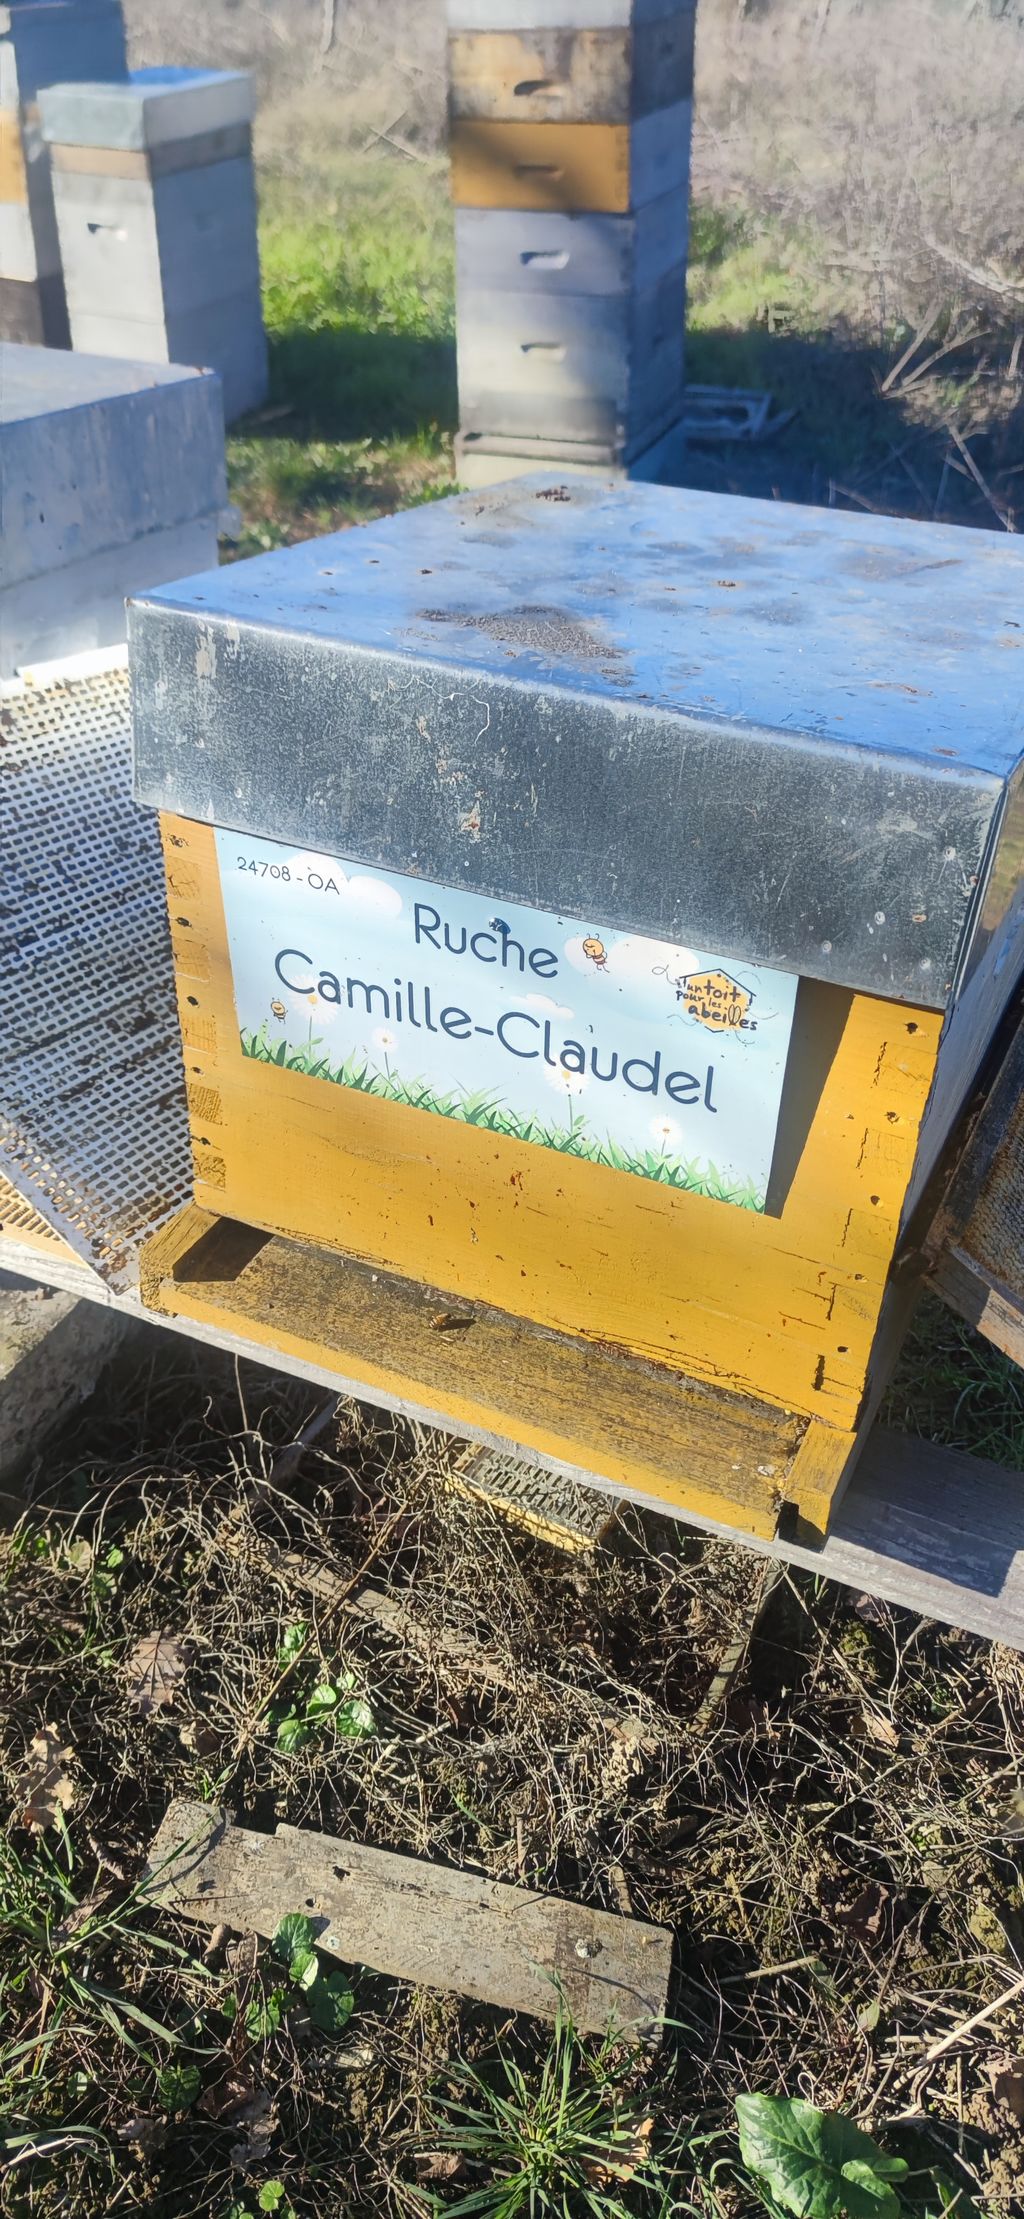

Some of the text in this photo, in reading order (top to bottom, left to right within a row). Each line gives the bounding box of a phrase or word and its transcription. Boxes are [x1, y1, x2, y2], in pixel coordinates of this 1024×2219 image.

[237, 856, 291, 882] 24708
[414, 902, 559, 978] Ruche
[687, 979, 741, 1003] un toit
[274, 948, 718, 1113] Camille-Claudel
[688, 1002, 758, 1031] abeilles
